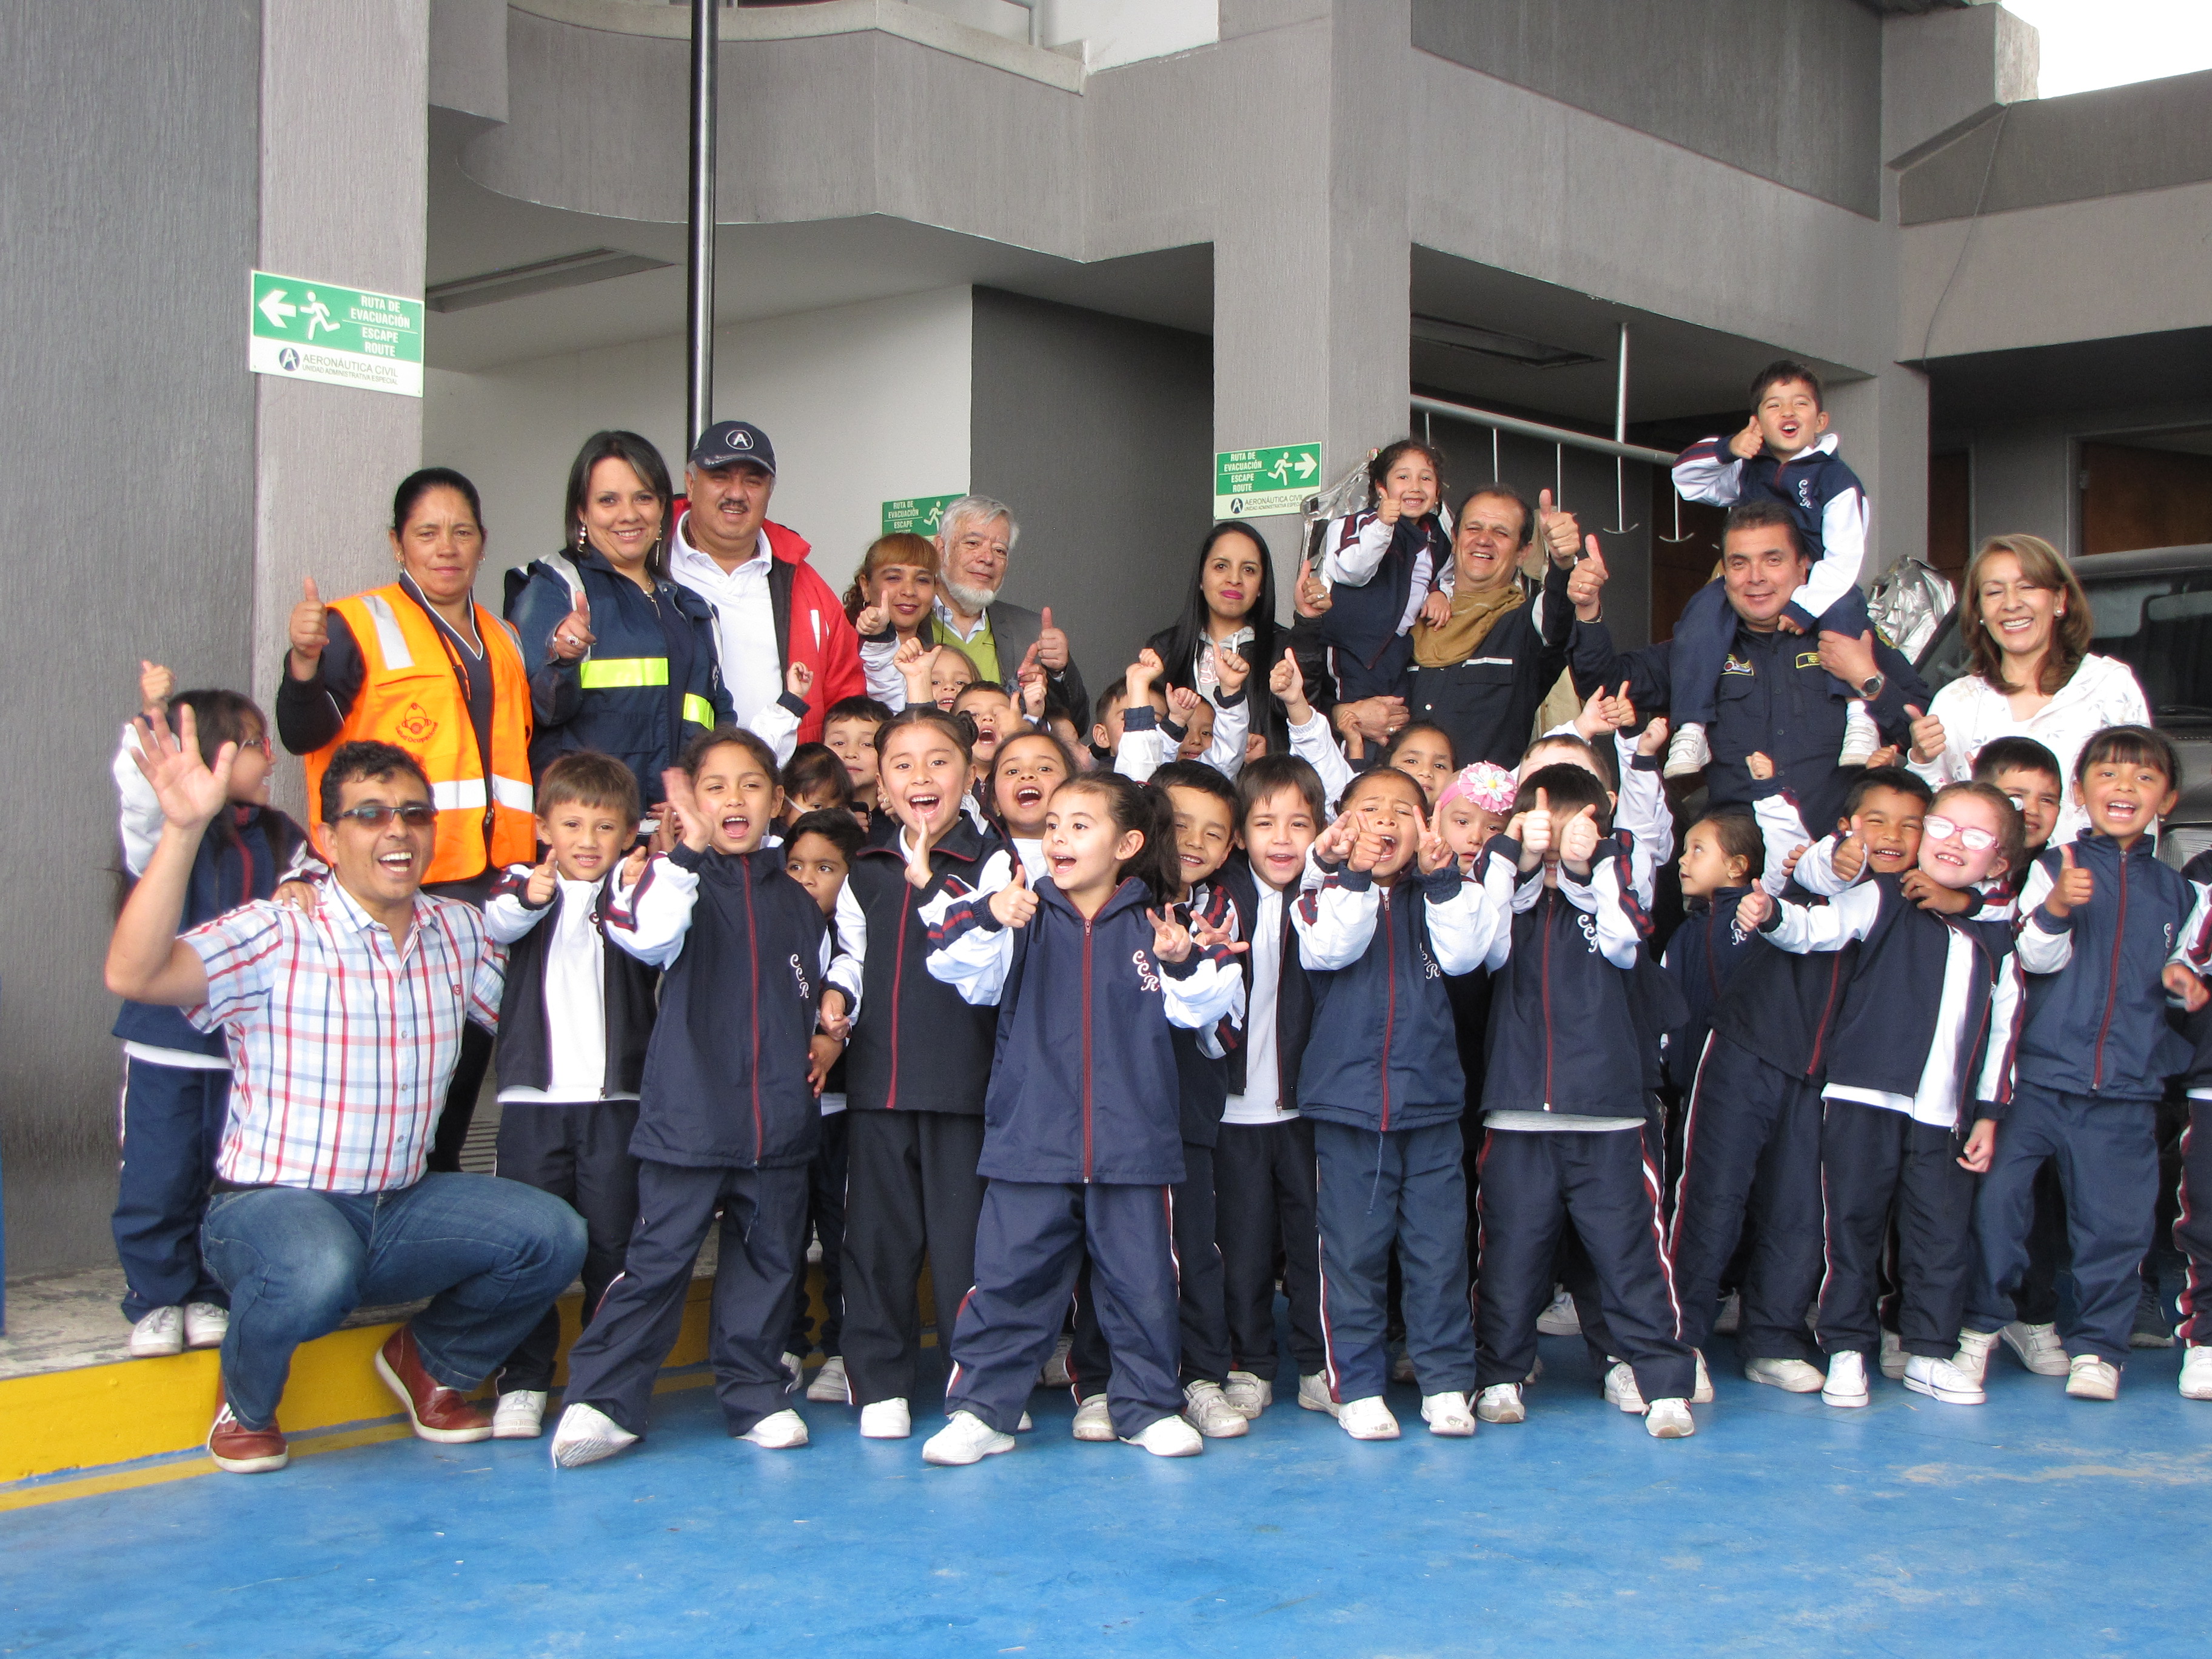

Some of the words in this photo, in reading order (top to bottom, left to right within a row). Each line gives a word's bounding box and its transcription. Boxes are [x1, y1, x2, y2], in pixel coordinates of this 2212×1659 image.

[361, 295, 386, 311] RUTA
[388, 300, 400, 313] DE
[350, 307, 410, 329] EVACUACIÓN
[362, 327, 398, 343] ESCAPE
[365, 341, 395, 357] ROUTE
[303, 354, 373, 374] AERONÁUTICA
[375, 365, 398, 377] CIVIL
[303, 364, 324, 373] UNIDAD
[325, 369, 371, 381] ADMINISTRATIVA
[372, 376, 398, 385] ESPECIAL
[1230, 453, 1247, 461] RUTA
[1224, 460, 1262, 472] EVACUACIÓN
[1231, 474, 1254, 483] ESCAPE
[1233, 483, 1253, 492] ROUTE
[1245, 495, 1288, 506] AERONÁUTICA
[888, 508, 919, 518] EVACUACIÓN
[894, 520, 913, 529] ESCAPE
